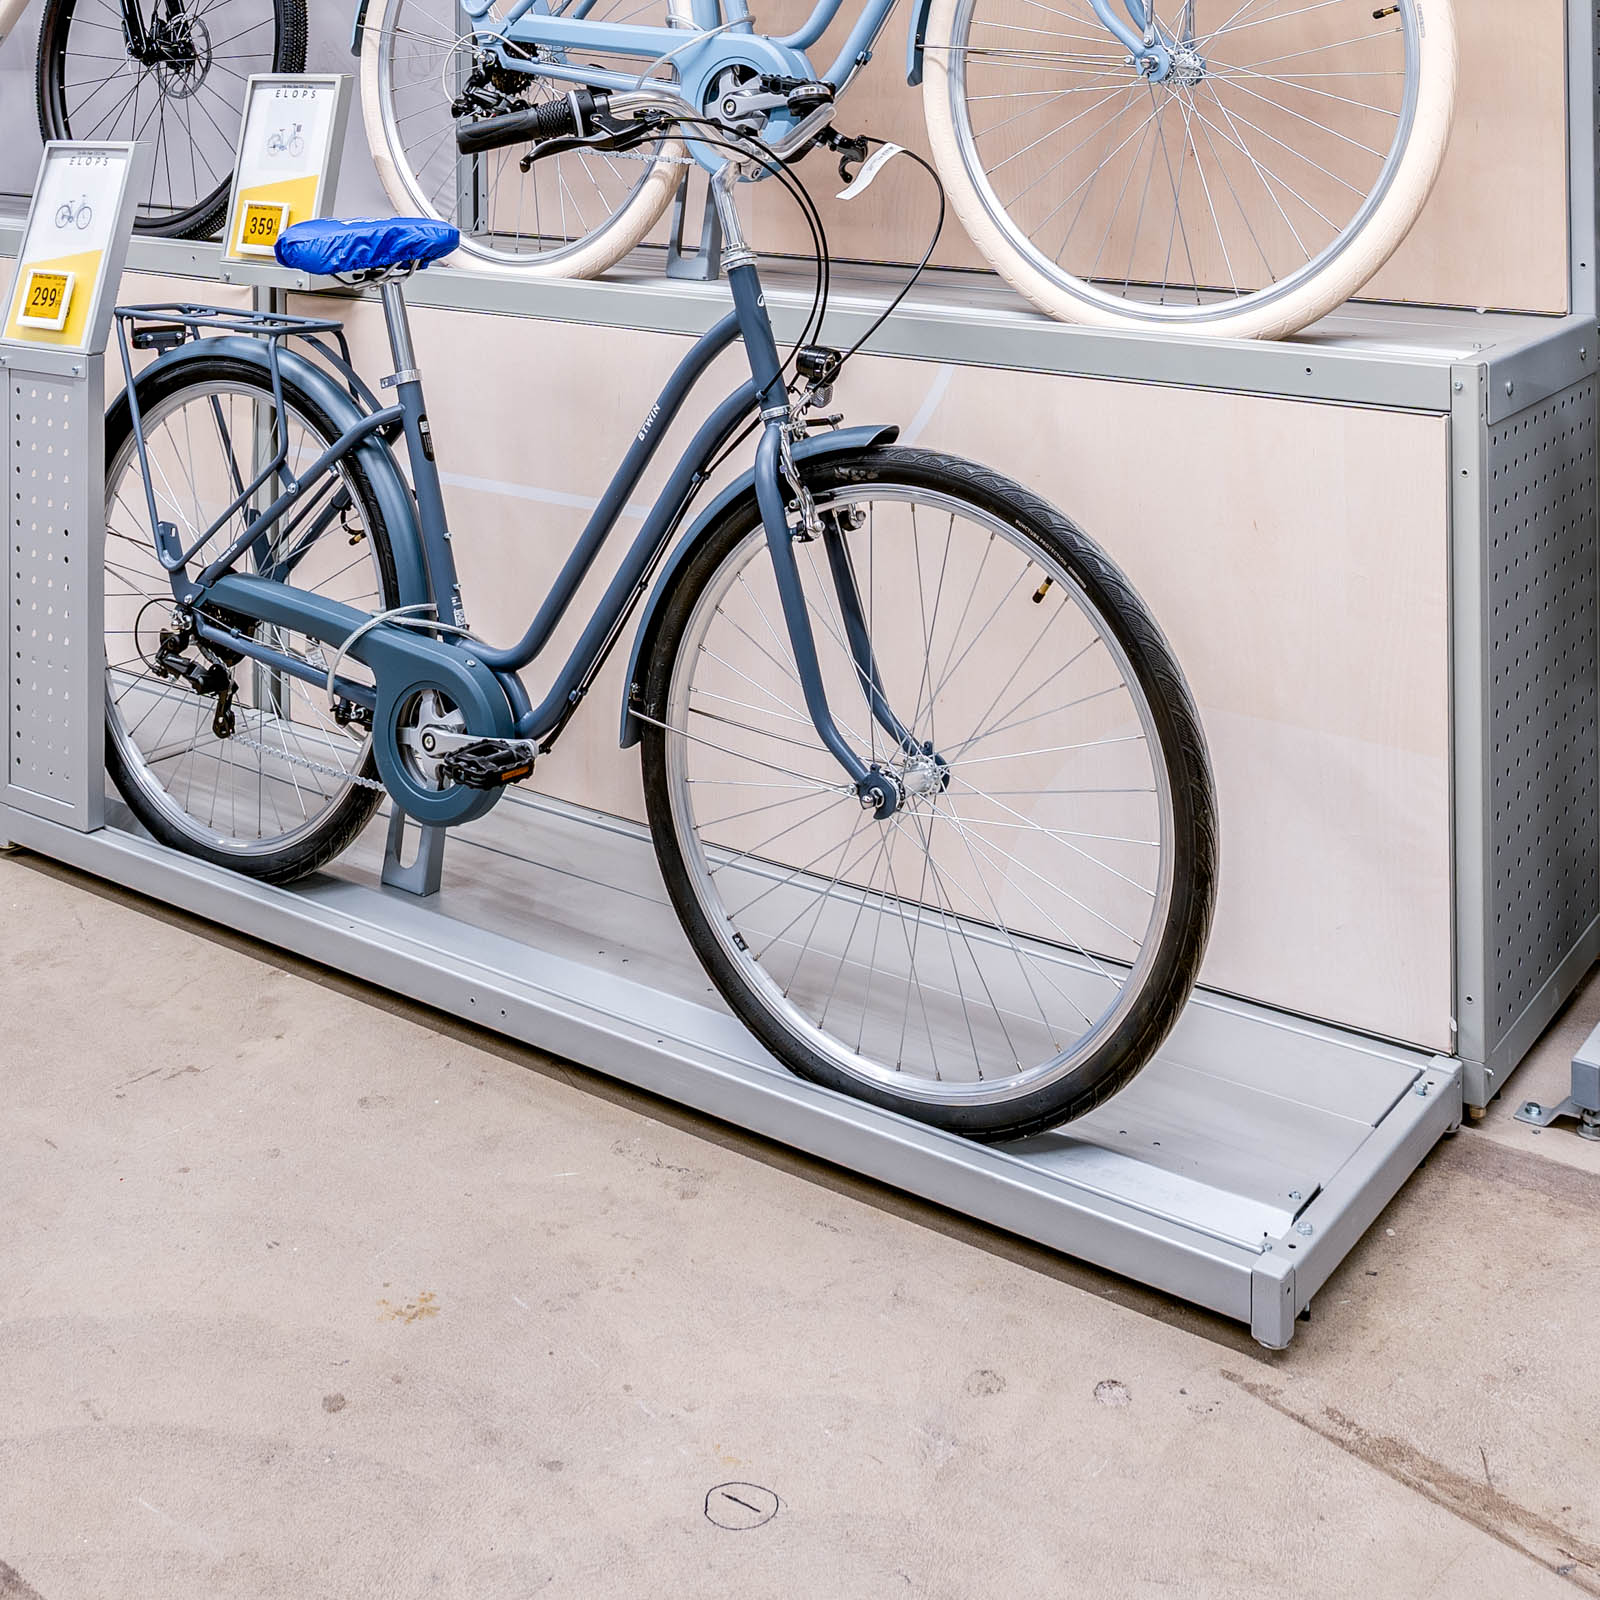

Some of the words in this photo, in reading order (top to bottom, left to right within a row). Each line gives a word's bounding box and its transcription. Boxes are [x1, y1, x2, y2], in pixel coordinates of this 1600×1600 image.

[275, 89, 317, 99] ELOPS
[69, 156, 109, 166] ELOPS
[249, 216, 274, 236] 359
[31, 286, 57, 307] 299
[637, 403, 661, 441] BTWIN
[1015, 519, 1041, 540] PUNCTURE
[1040, 538, 1068, 566] PROTECTION
